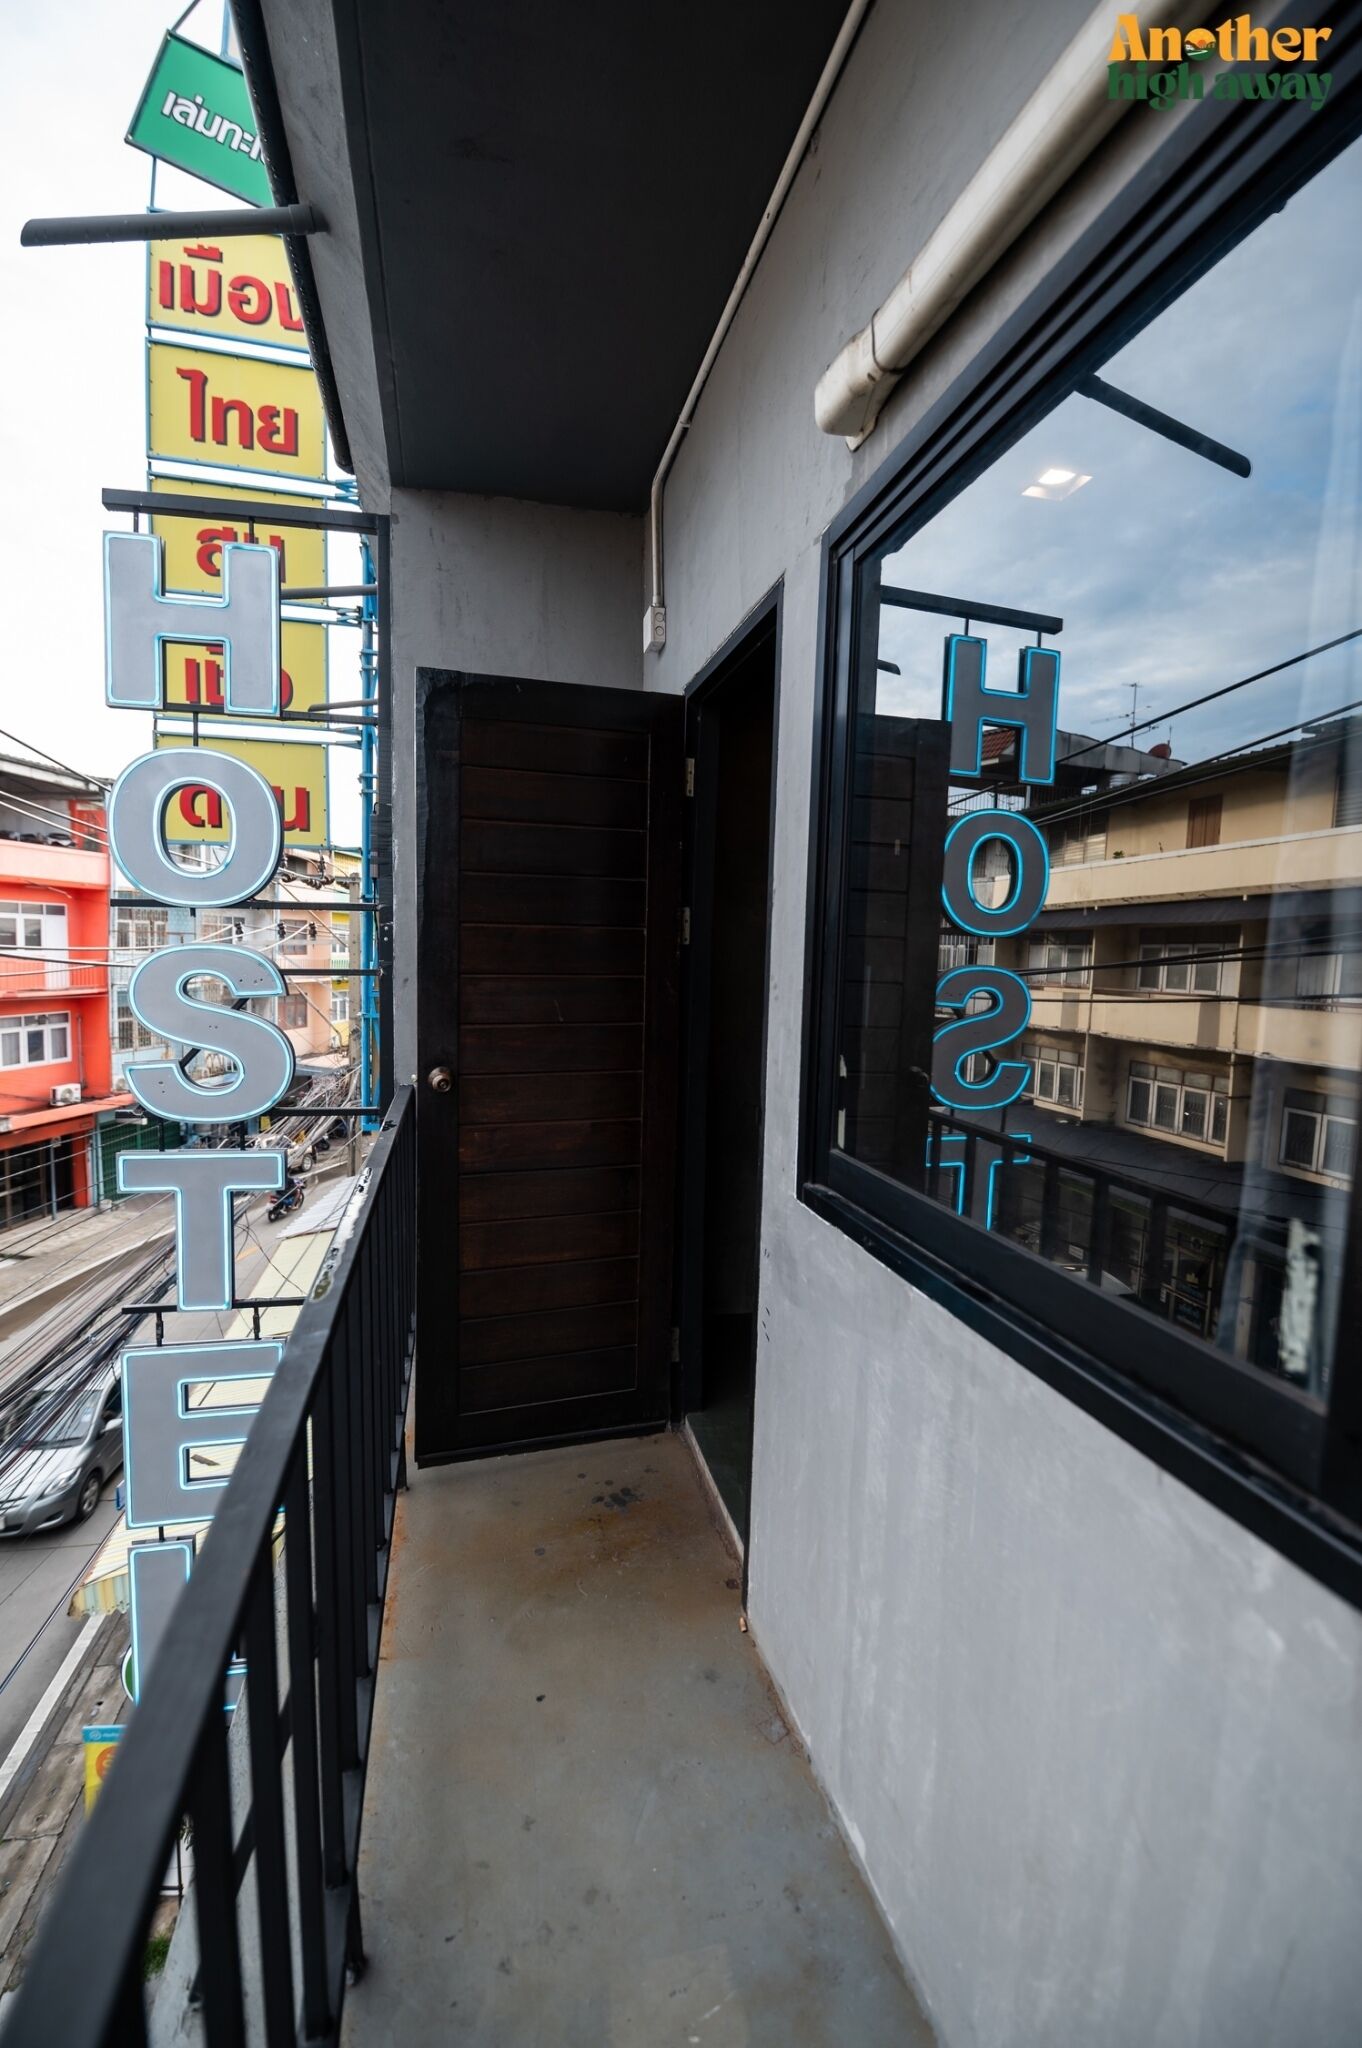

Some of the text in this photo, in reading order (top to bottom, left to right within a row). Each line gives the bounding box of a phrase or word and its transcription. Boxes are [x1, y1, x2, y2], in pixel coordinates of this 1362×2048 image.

[161, 90, 265, 165] เล่มทะเ
[176, 366, 299, 456] ไทย
